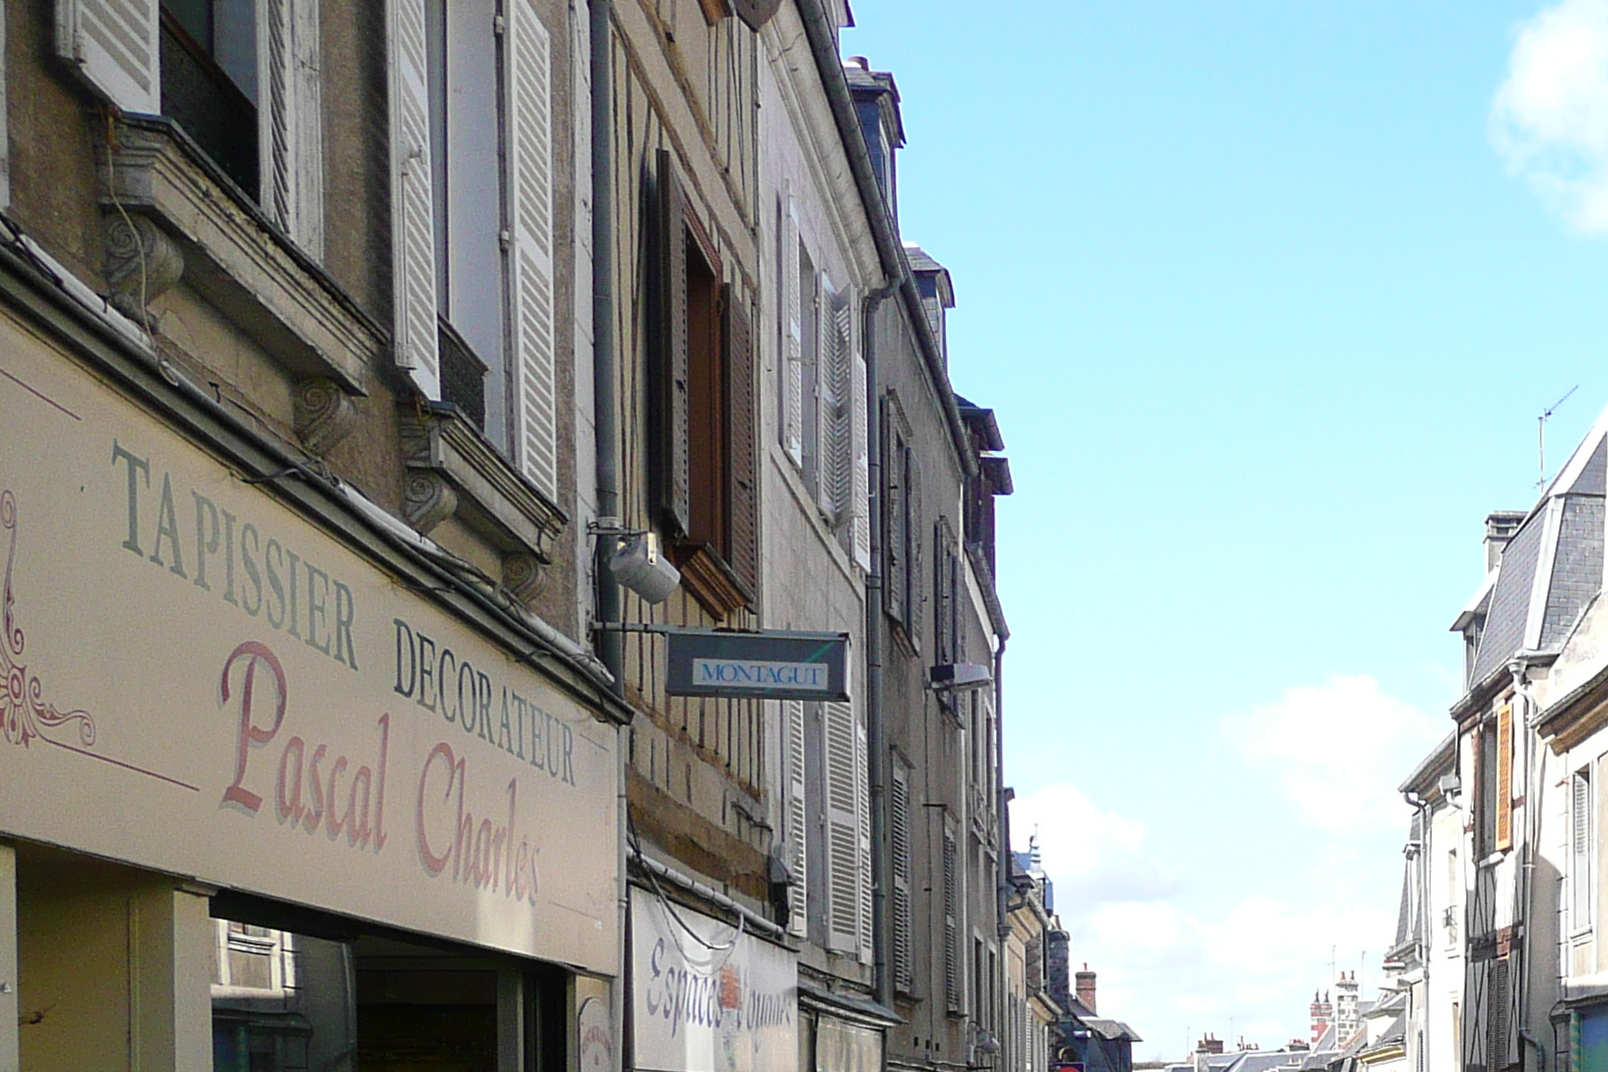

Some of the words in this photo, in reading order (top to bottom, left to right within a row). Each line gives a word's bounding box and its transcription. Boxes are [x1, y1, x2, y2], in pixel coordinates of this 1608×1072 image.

[111, 437, 359, 672] TAPISSIER
[392, 617, 577, 788] DECORATEUR
[702, 663, 823, 685] MONTAGUT
[217, 638, 390, 858] Pascal
[412, 741, 542, 907] Charles
[646, 936, 724, 1039] Espaces
